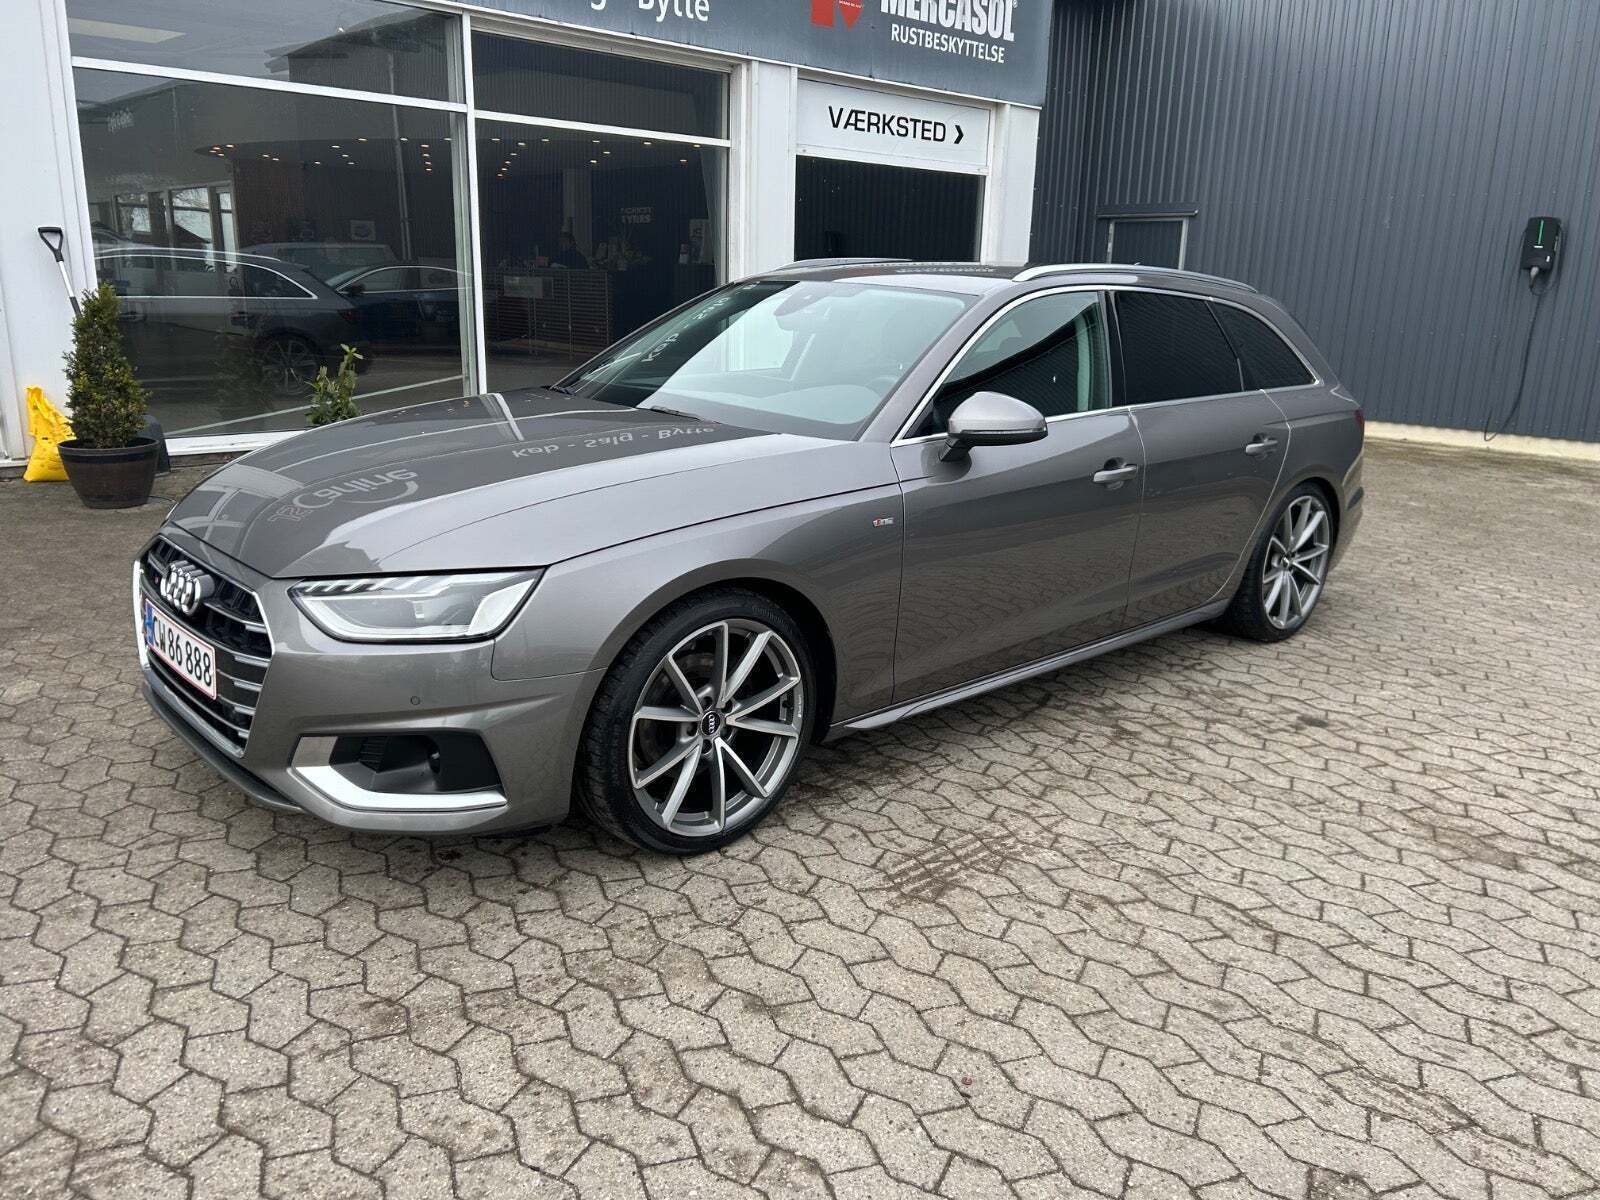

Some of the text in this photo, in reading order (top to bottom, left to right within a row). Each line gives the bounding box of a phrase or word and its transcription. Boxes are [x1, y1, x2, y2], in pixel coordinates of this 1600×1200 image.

[891, 23, 1005, 63] RUSTBESKYTTELSE
[828, 105, 947, 142] VÆRKSTED
[153, 615, 212, 687] CW 86 888
